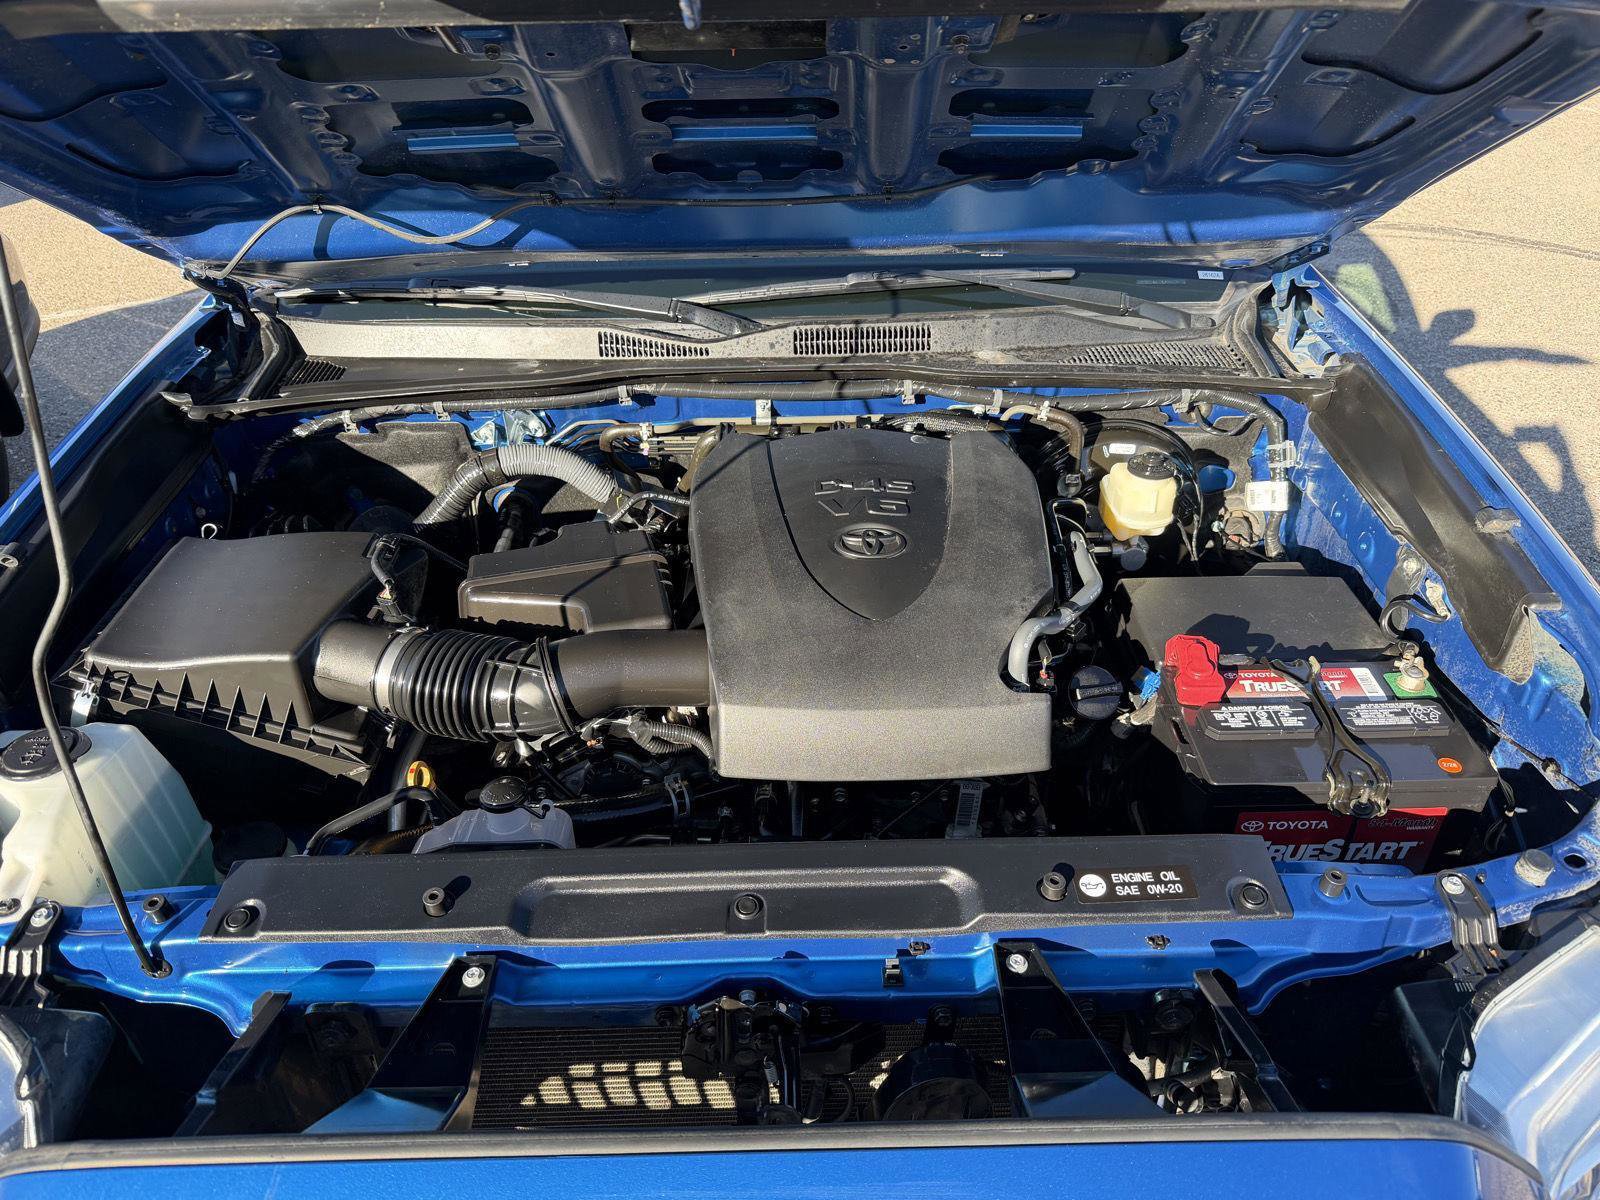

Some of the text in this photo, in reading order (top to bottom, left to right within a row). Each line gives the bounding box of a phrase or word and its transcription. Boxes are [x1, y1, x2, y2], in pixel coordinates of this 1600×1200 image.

[813, 479, 917, 495] D-4S
[817, 498, 911, 517] V6
[1267, 820, 1329, 831] TOYOTA
[1265, 838, 1418, 862] RUESTART
[1111, 870, 1181, 883] ENGINE OIL
[1115, 883, 1183, 896] SAE 0W-20
